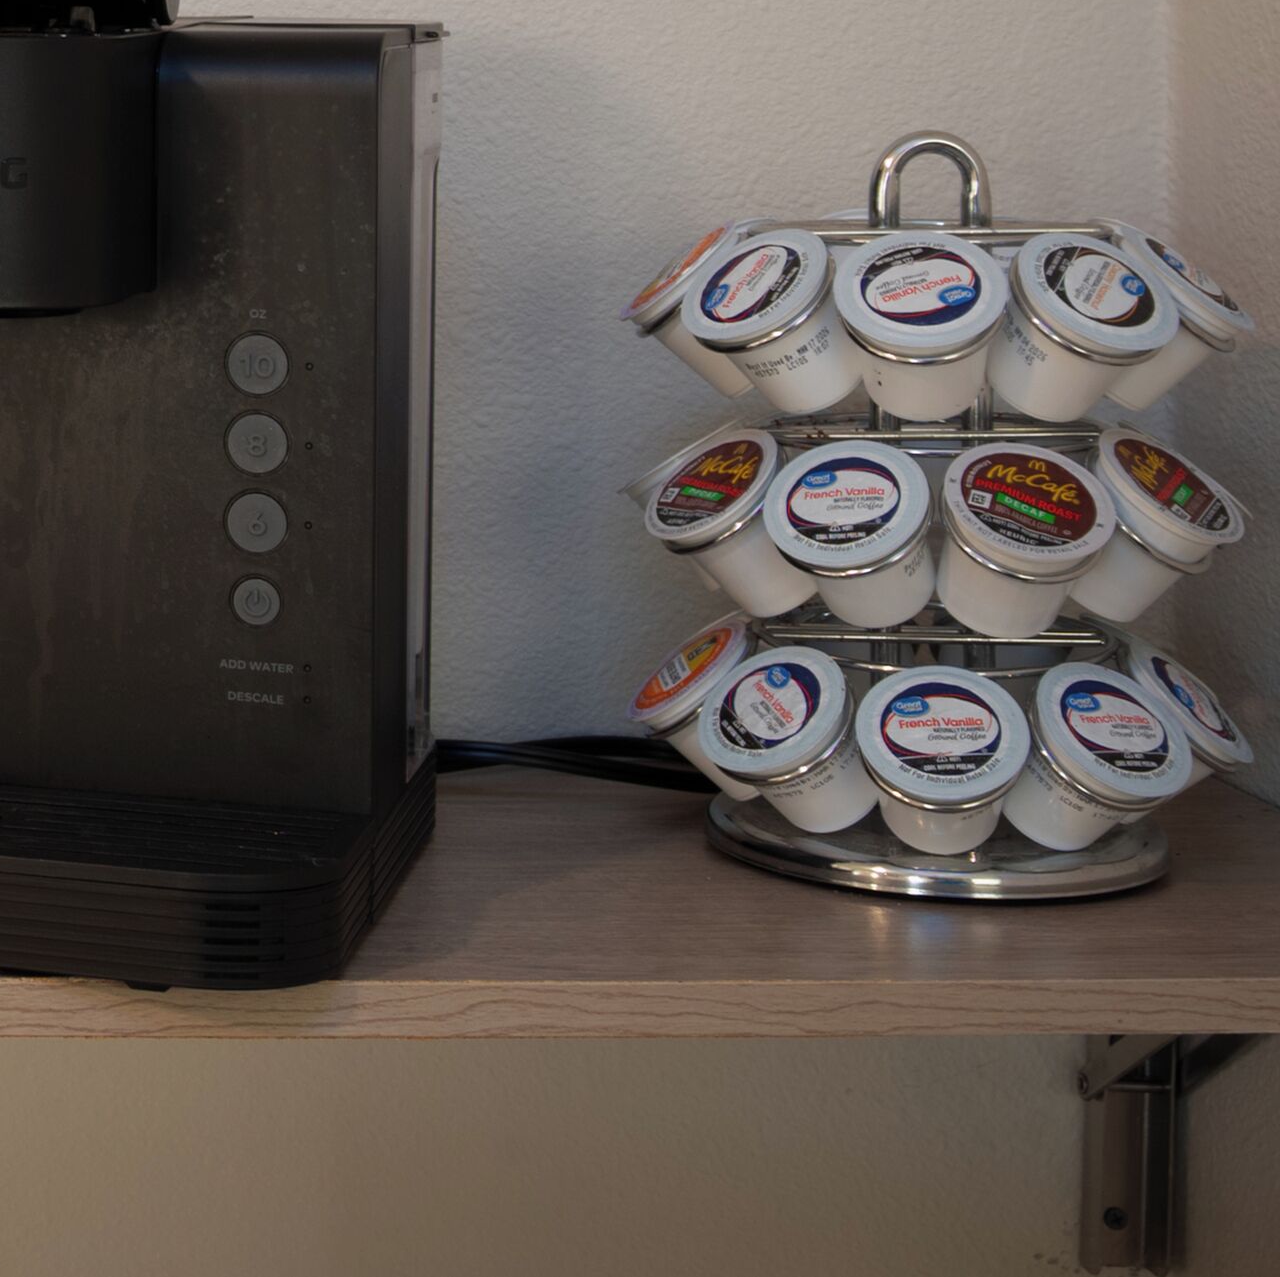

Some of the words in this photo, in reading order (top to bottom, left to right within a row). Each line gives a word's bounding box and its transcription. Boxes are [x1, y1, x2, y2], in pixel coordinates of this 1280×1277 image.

[921, 275, 963, 292] French
[880, 286, 920, 304] Vanilla
[249, 308, 267, 319] OZ
[240, 354, 277, 378] 10
[248, 434, 268, 458] 8
[804, 488, 843, 500] French
[845, 487, 885, 496] Vanilla
[975, 478, 1036, 506] PREMIUM
[1037, 499, 1082, 521] ROAST
[1004, 495, 1048, 518] DECAF
[248, 512, 268, 537] 6
[220, 659, 246, 670] ADD
[249, 661, 294, 674] WATER
[227, 691, 284, 705] DESCALE
[898, 717, 940, 729] French
[941, 717, 984, 727] Vanilla
[1079, 713, 1116, 725] French
[1117, 714, 1151, 725] Vanilla
[959, 732, 987, 742] Coffee
